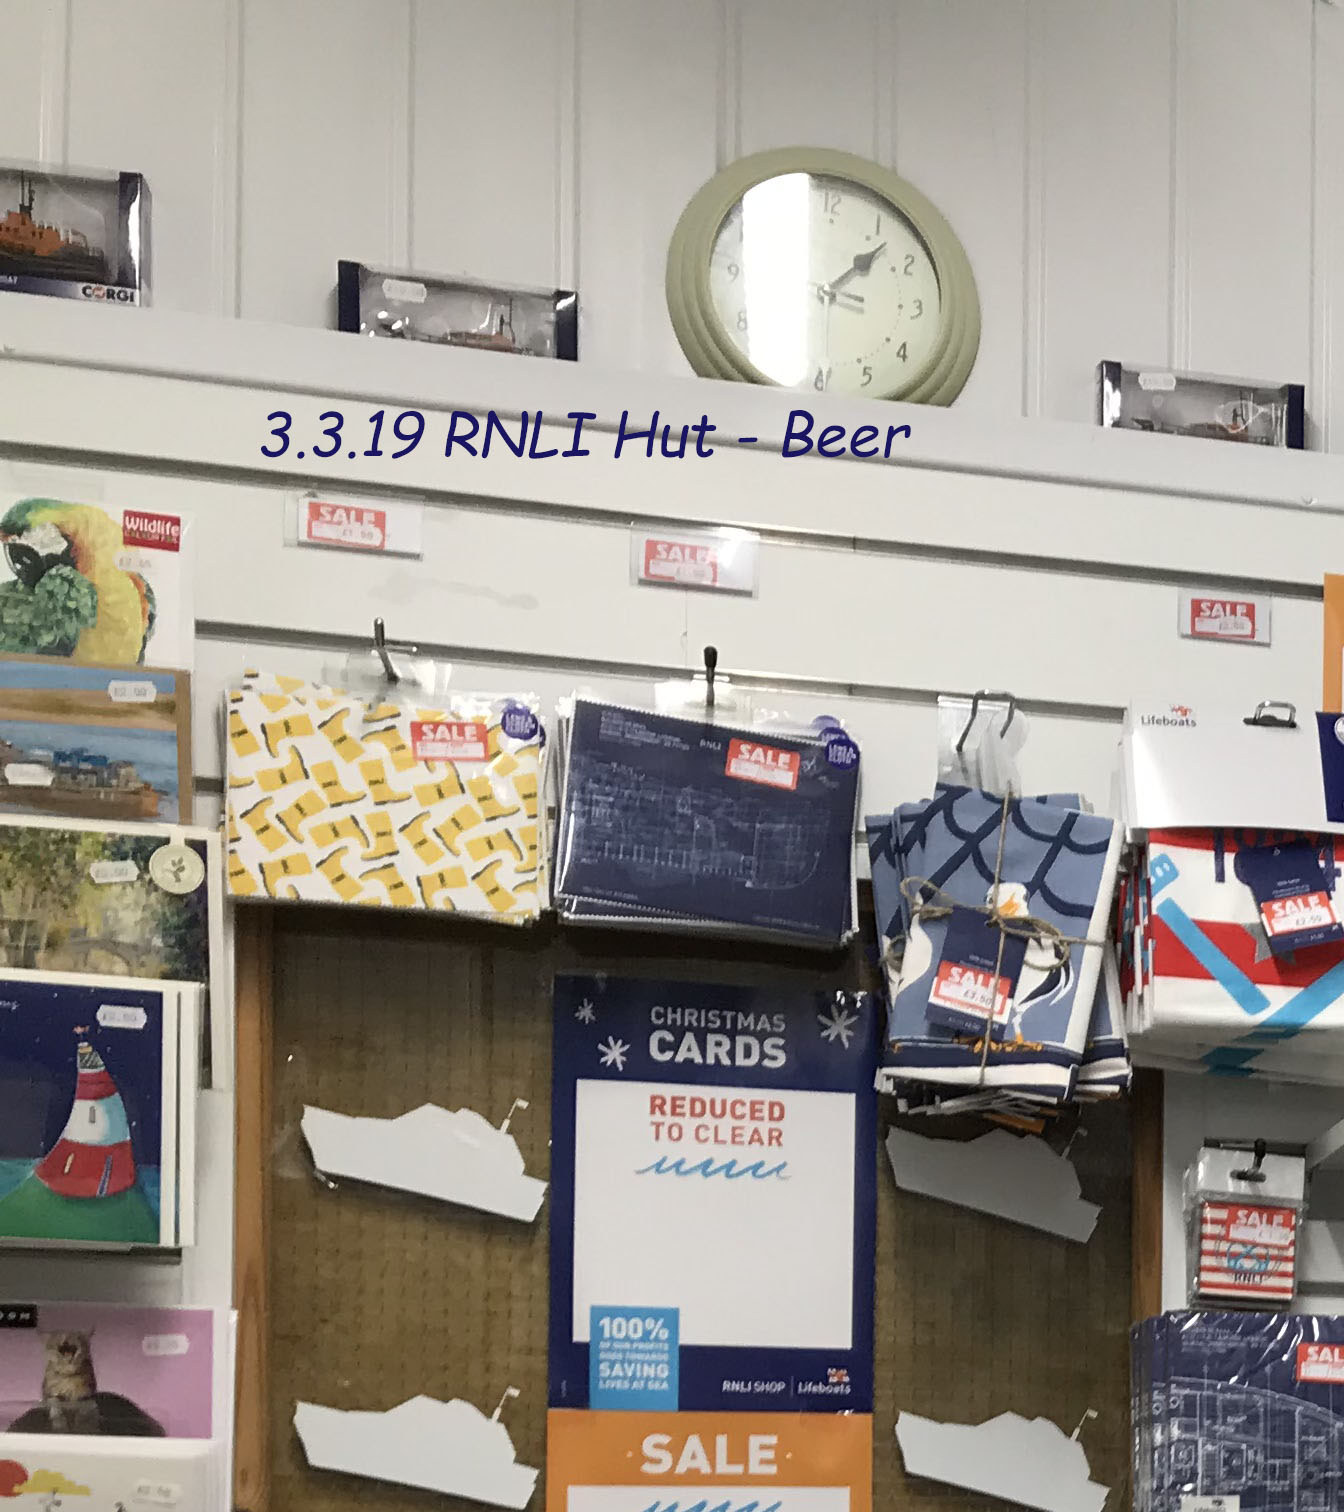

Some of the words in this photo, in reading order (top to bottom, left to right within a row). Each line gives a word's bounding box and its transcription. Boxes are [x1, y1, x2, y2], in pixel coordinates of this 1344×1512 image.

[822, 192, 842, 215] 12
[903, 255, 915, 276] 2
[82, 284, 134, 303] CORGI
[910, 299, 924, 320] 3
[896, 341, 909, 362] 4
[860, 366, 872, 386] 5
[125, 515, 180, 536] Wildlife
[318, 507, 376, 526] SALE
[1200, 601, 1247, 617] SALE
[1141, 714, 1197, 728] Lifeboats
[421, 724, 478, 742] SALE
[736, 744, 792, 770] SALE
[1271, 897, 1320, 915] SALE
[651, 1006, 786, 1033] CHRISTMAS
[649, 1030, 787, 1068] CARDS
[650, 1095, 785, 1121] REDUCED
[651, 1122, 682, 1142] TO
[694, 1124, 783, 1147] CLEAR
[1236, 1210, 1283, 1227] SALE
[599, 1317, 668, 1339] 100%
[599, 1363, 668, 1378] SAVING
[722, 1380, 751, 1394] RNLI
[798, 1382, 851, 1395] Lifeboats
[641, 1433, 778, 1474] SALE
